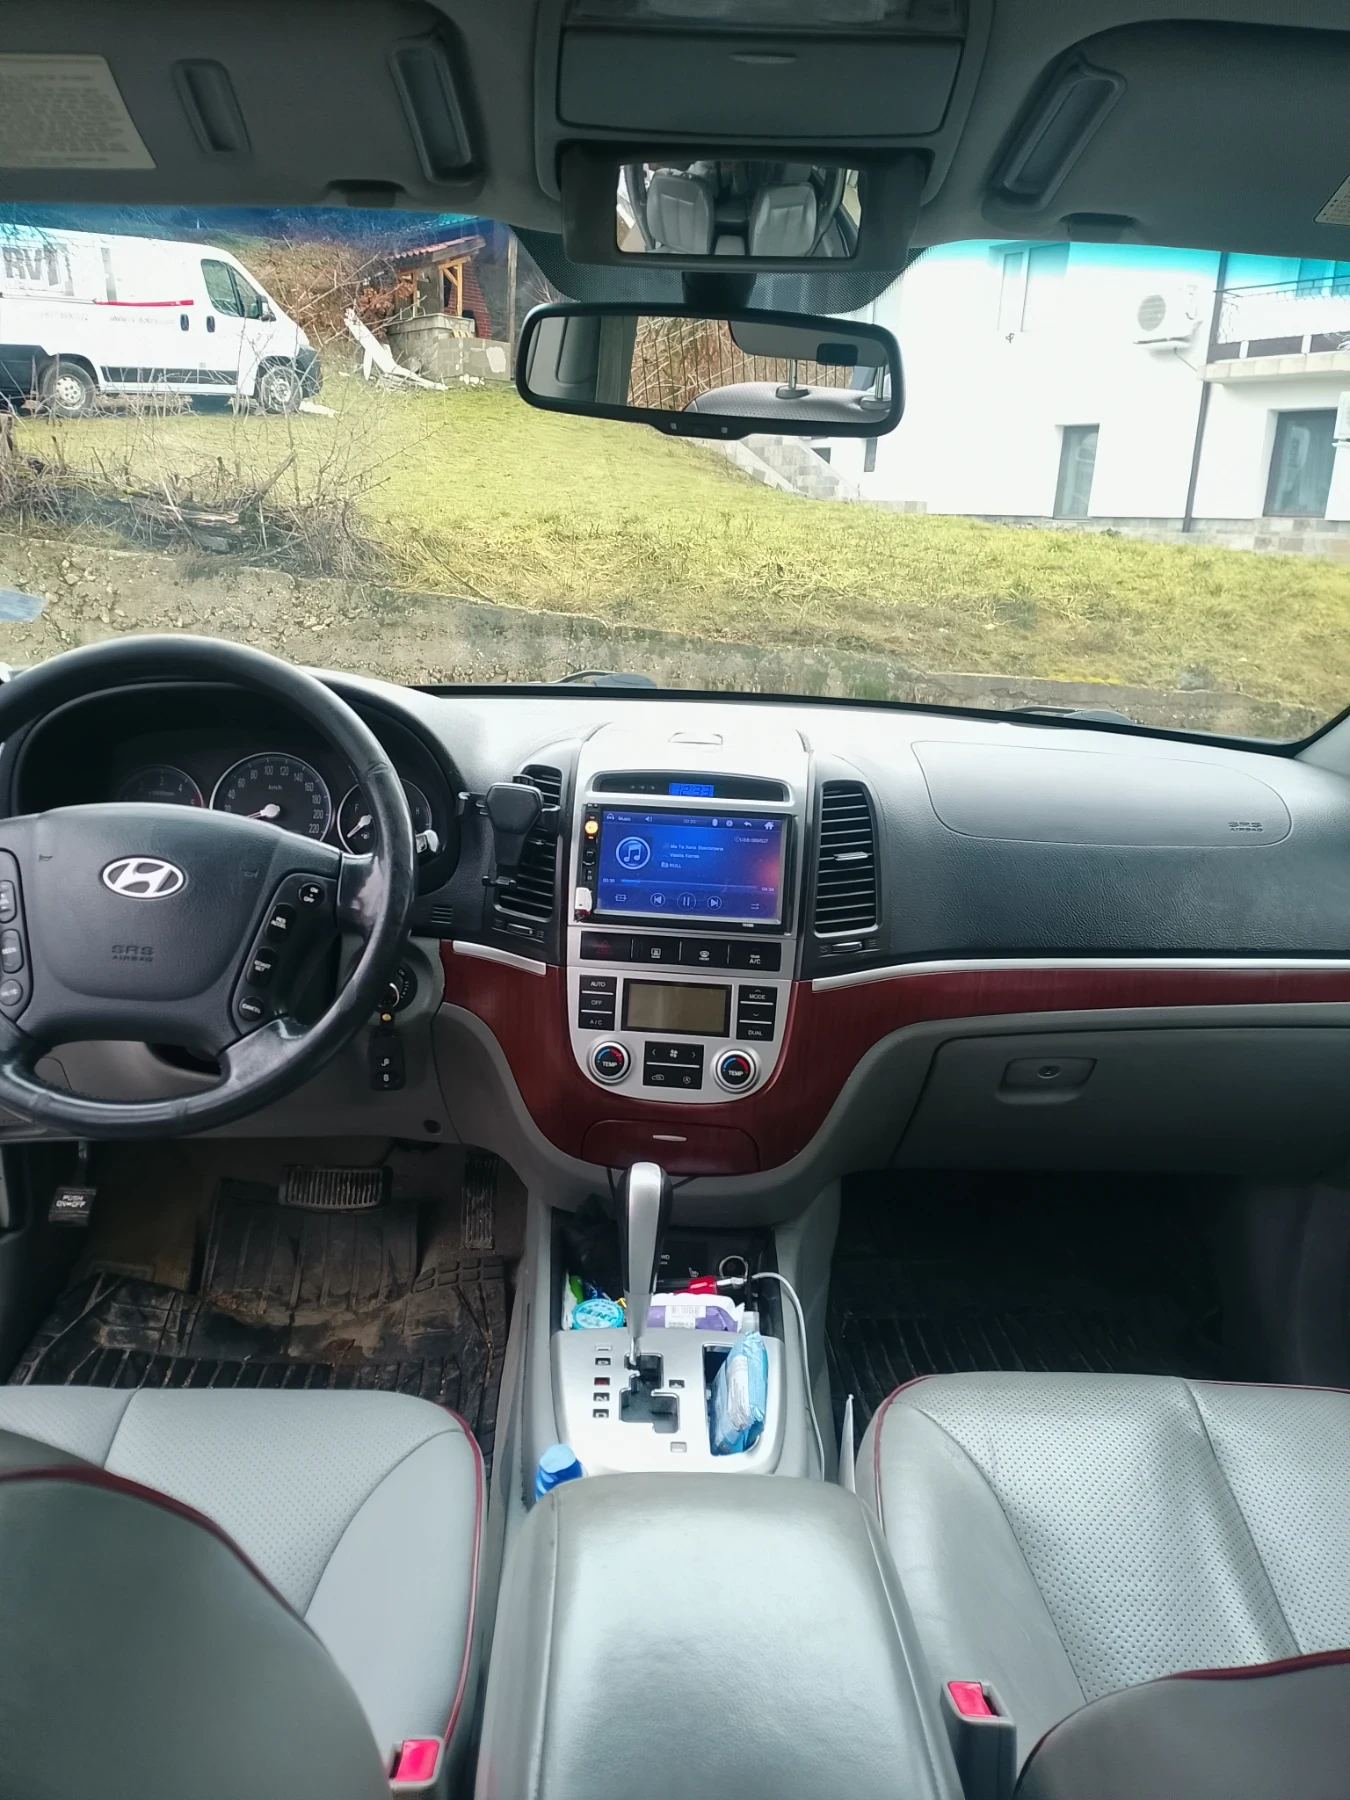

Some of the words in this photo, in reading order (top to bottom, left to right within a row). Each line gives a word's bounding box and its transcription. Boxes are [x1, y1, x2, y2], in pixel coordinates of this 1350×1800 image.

[250, 770, 258, 779] 80
[264, 766, 273, 775] 100
[280, 766, 289, 775] 120
[294, 773, 303, 782] 140
[238, 778, 245, 788] 60
[305, 782, 314, 792] 160
[228, 790, 235, 799] 40
[312, 794, 321, 804] 180
[313, 810, 323, 819] 200
[415, 807, 420, 815] H
[308, 823, 319, 833] 220
[111, 944, 155, 956] SRS
[728, 1069, 744, 1077] TEMP
[62, 1194, 85, 1202] PUSH
